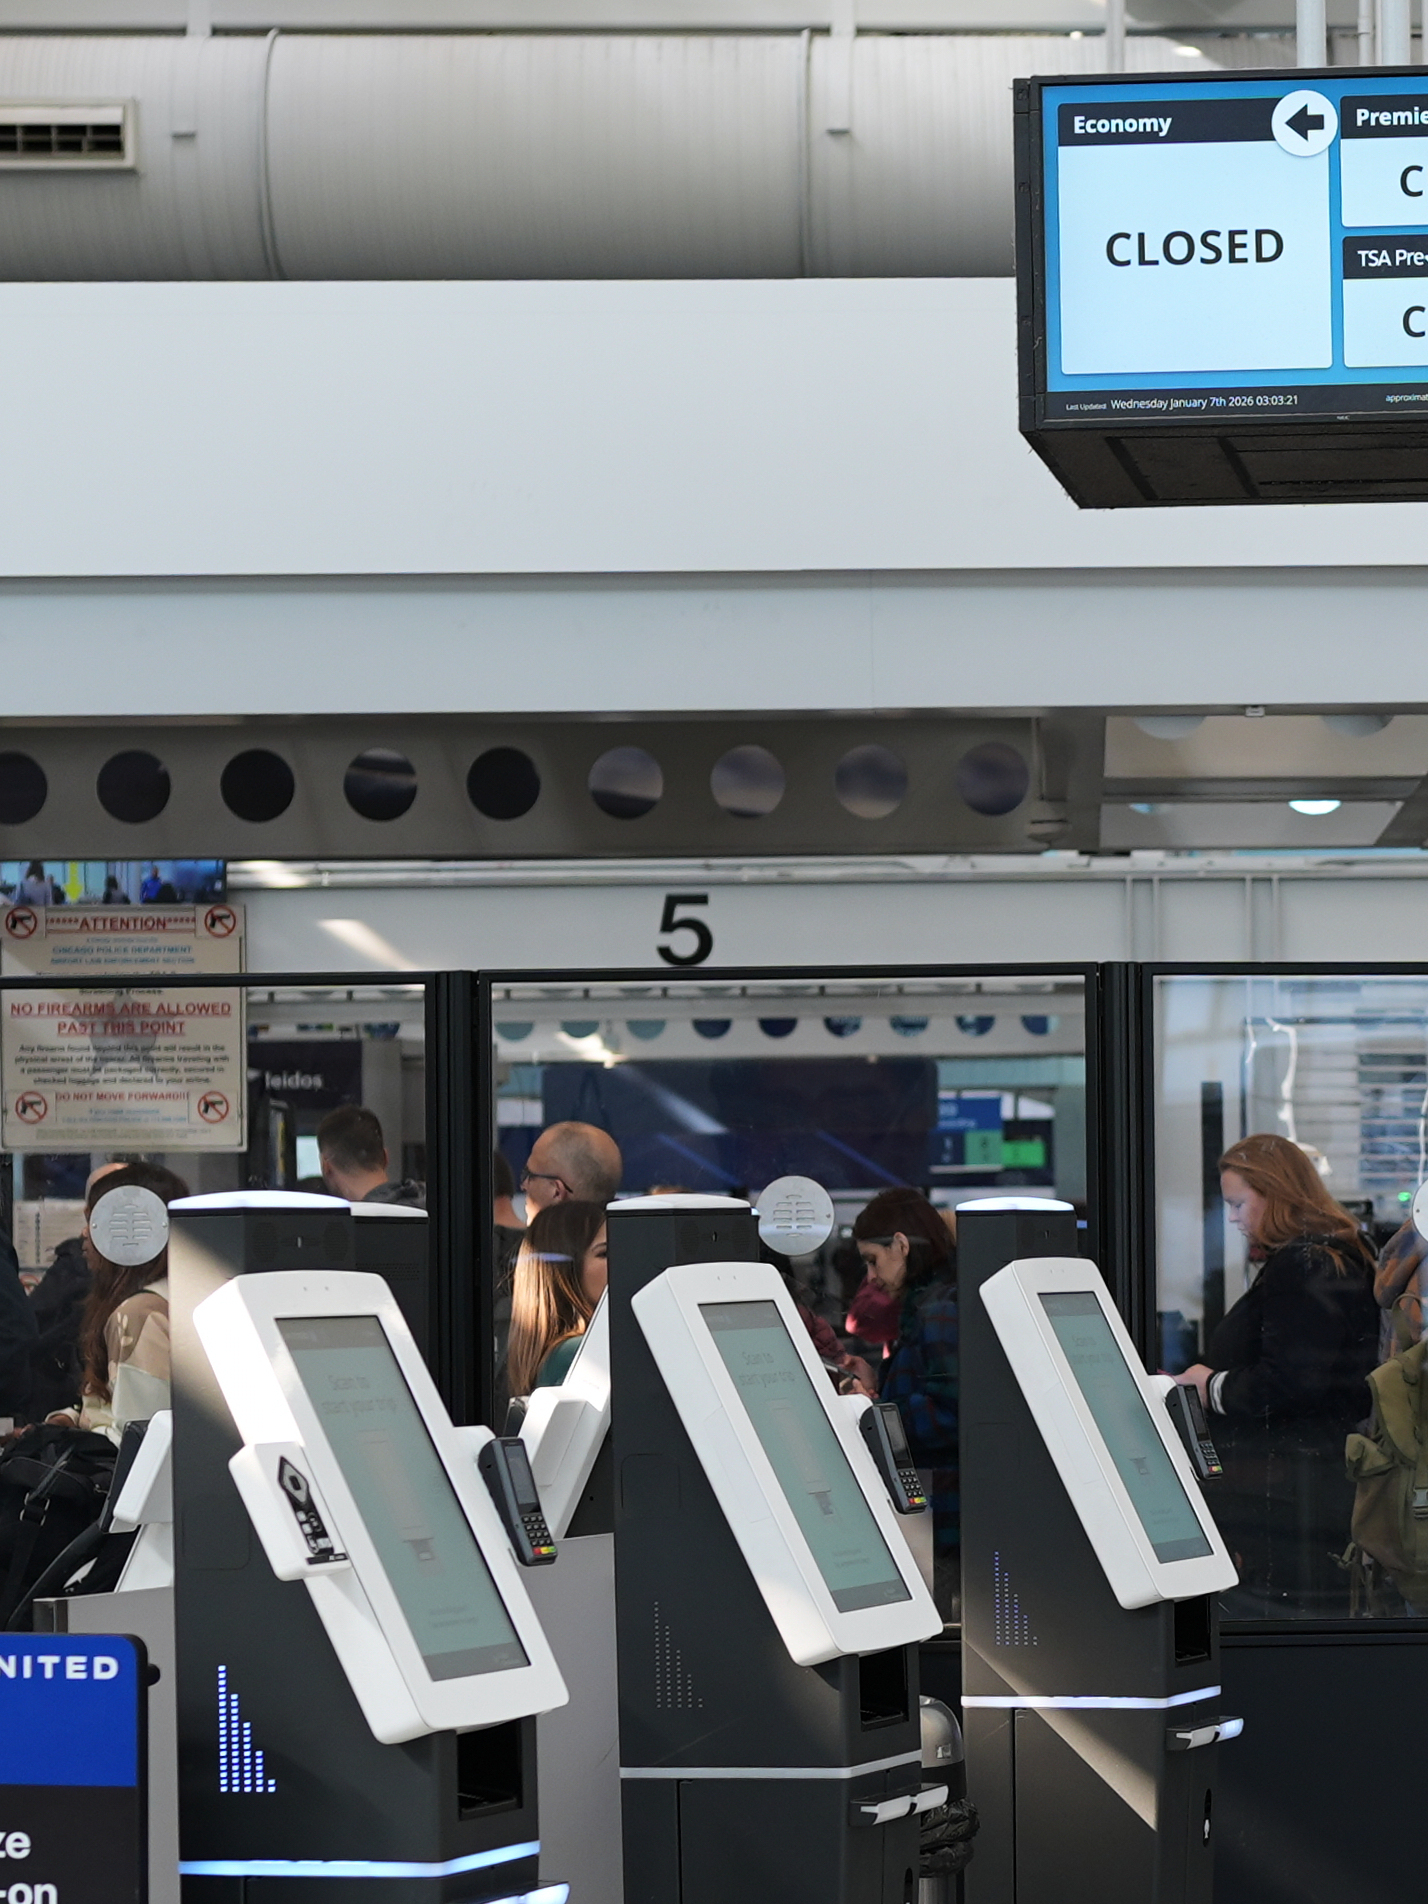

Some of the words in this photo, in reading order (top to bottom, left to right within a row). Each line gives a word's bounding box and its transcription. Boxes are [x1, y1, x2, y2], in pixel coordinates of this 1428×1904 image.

[1073, 114, 1172, 137] Economy
[1106, 229, 1284, 267] CLOSED
[1357, 250, 1392, 267] TSA
[1065, 403, 1078, 411] Last
[1110, 398, 1168, 411] Wednesday
[1169, 397, 1208, 411] January
[1209, 396, 1226, 407] 7th
[1228, 396, 1254, 407] 2026
[1256, 395, 1298, 407] 03:03:21
[656, 893, 714, 966] 5
[10, 1002, 33, 1016] NO
[37, 1002, 114, 1016] FIREARMS
[120, 1002, 151, 1016] ARE
[157, 1002, 231, 1016] ALLOWED
[58, 1021, 96, 1035] PAST
[103, 1021, 135, 1035] THIS
[141, 1021, 185, 1035] POINT
[265, 1069, 323, 1091] leidos
[72, 1091, 93, 1102] NOT
[96, 1091, 125, 1102] MOVE
